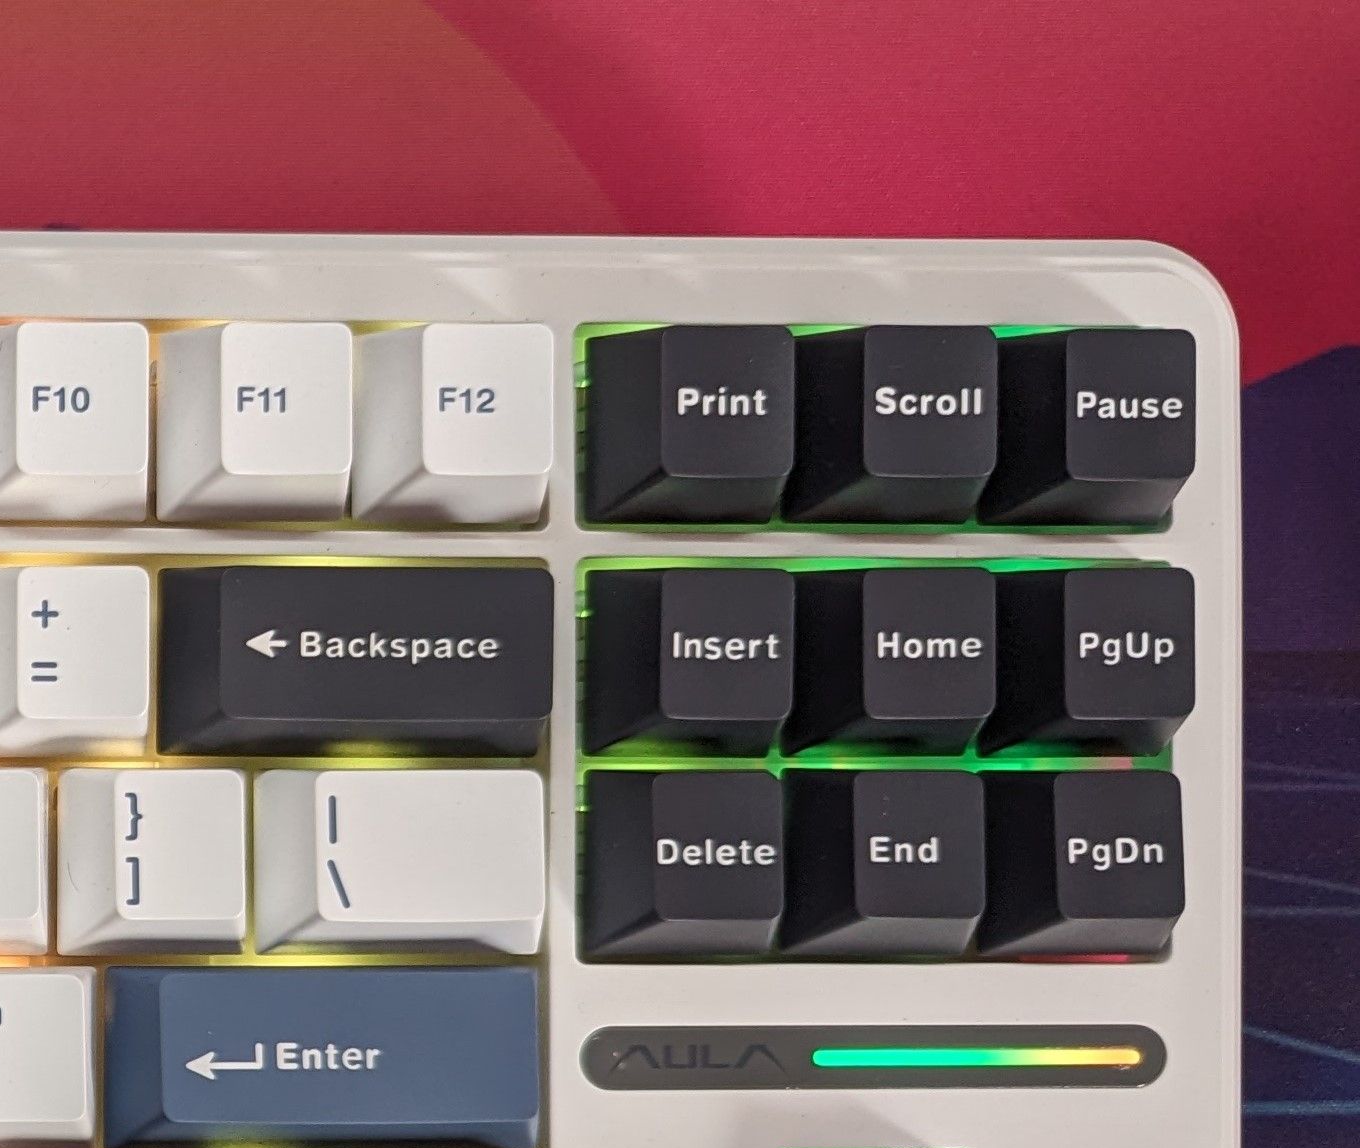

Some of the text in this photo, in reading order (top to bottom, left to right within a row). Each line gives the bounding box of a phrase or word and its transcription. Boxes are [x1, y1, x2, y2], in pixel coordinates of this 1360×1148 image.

[33, 386, 89, 412] F10
[238, 387, 285, 412] F11
[440, 387, 494, 413] F12
[678, 387, 766, 415] Print
[876, 387, 981, 415] Scroll
[1077, 392, 1182, 418] Pause
[32, 600, 59, 628] +
[301, 632, 498, 664] Backspace
[674, 632, 778, 660] Insert
[878, 632, 981, 658] Home
[1080, 632, 1174, 665] PgUp
[31, 662, 57, 682] =
[125, 793, 143, 840] }
[657, 839, 775, 865] Delete
[870, 837, 938, 863] End
[1068, 838, 1163, 870] PgDn
[126, 857, 140, 905] ]
[327, 860, 350, 908] \
[277, 1043, 380, 1069] Enter
[610, 1043, 789, 1077] AULA
